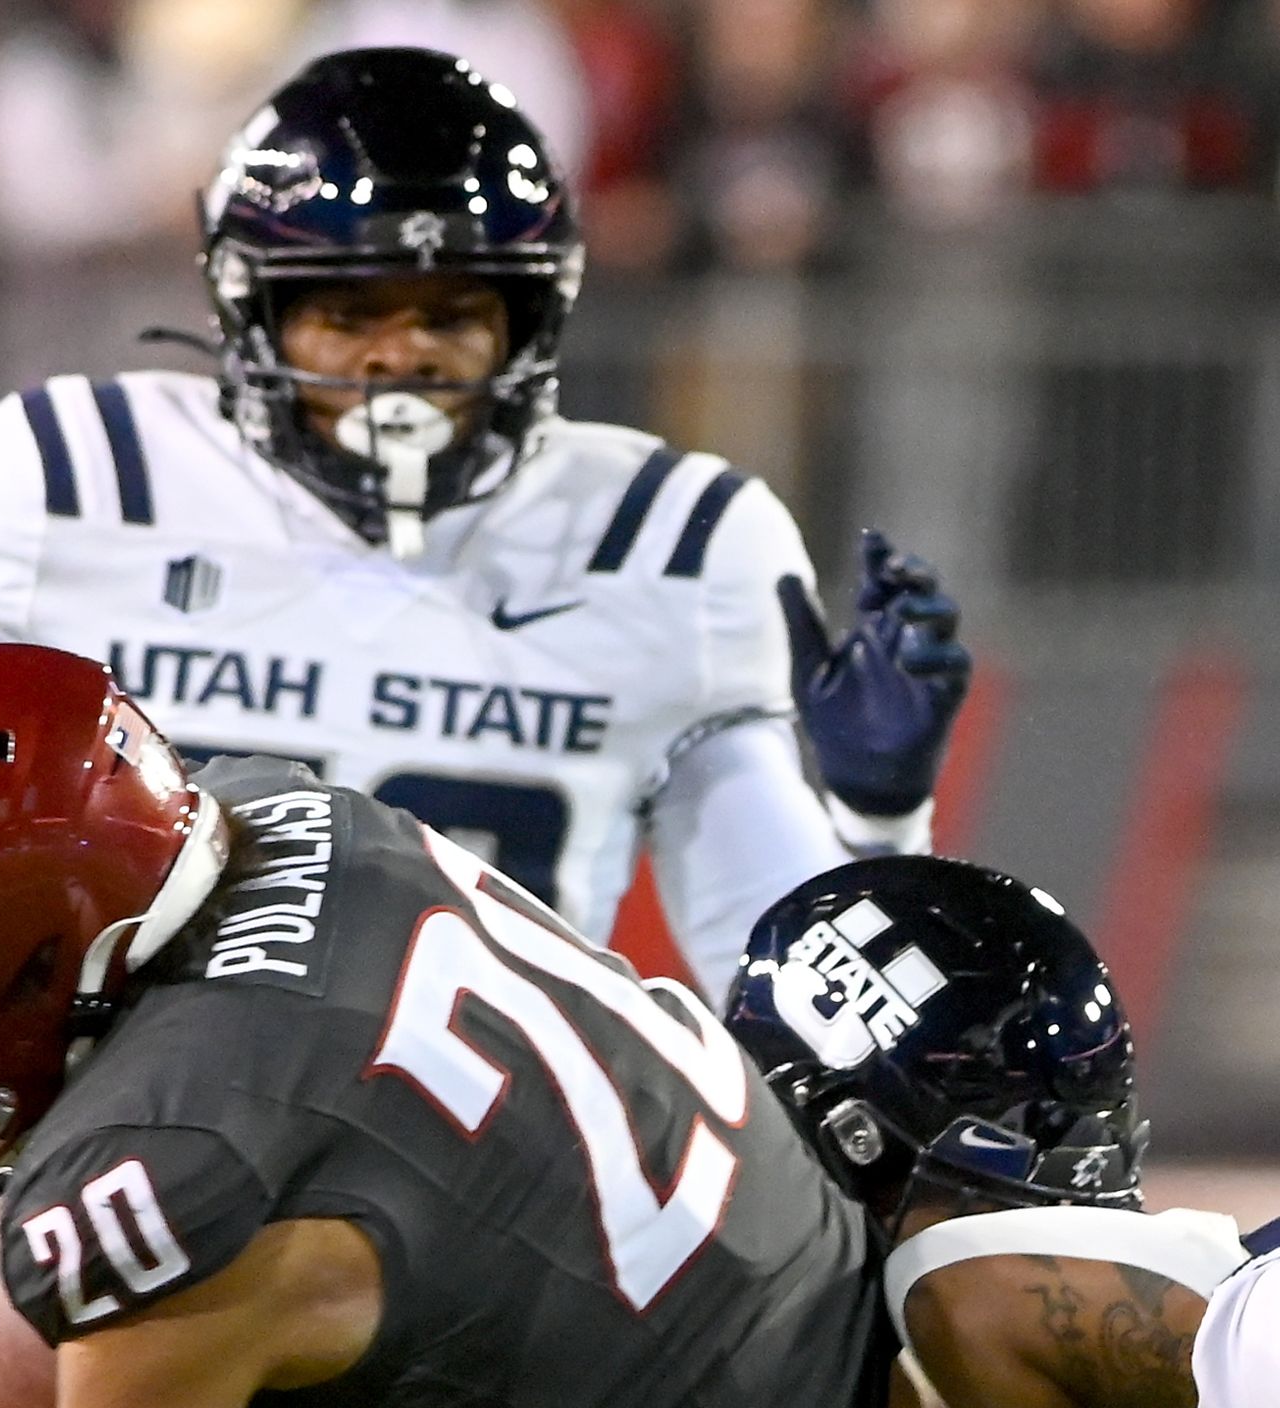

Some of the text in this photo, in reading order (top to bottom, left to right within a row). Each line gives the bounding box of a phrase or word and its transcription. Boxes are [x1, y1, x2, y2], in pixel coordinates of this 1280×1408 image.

[110, 641, 612, 754] UTAH STATE
[787, 920, 920, 1053] STATE
[361, 820, 748, 1318] 20
[21, 1158, 191, 1326] 20
